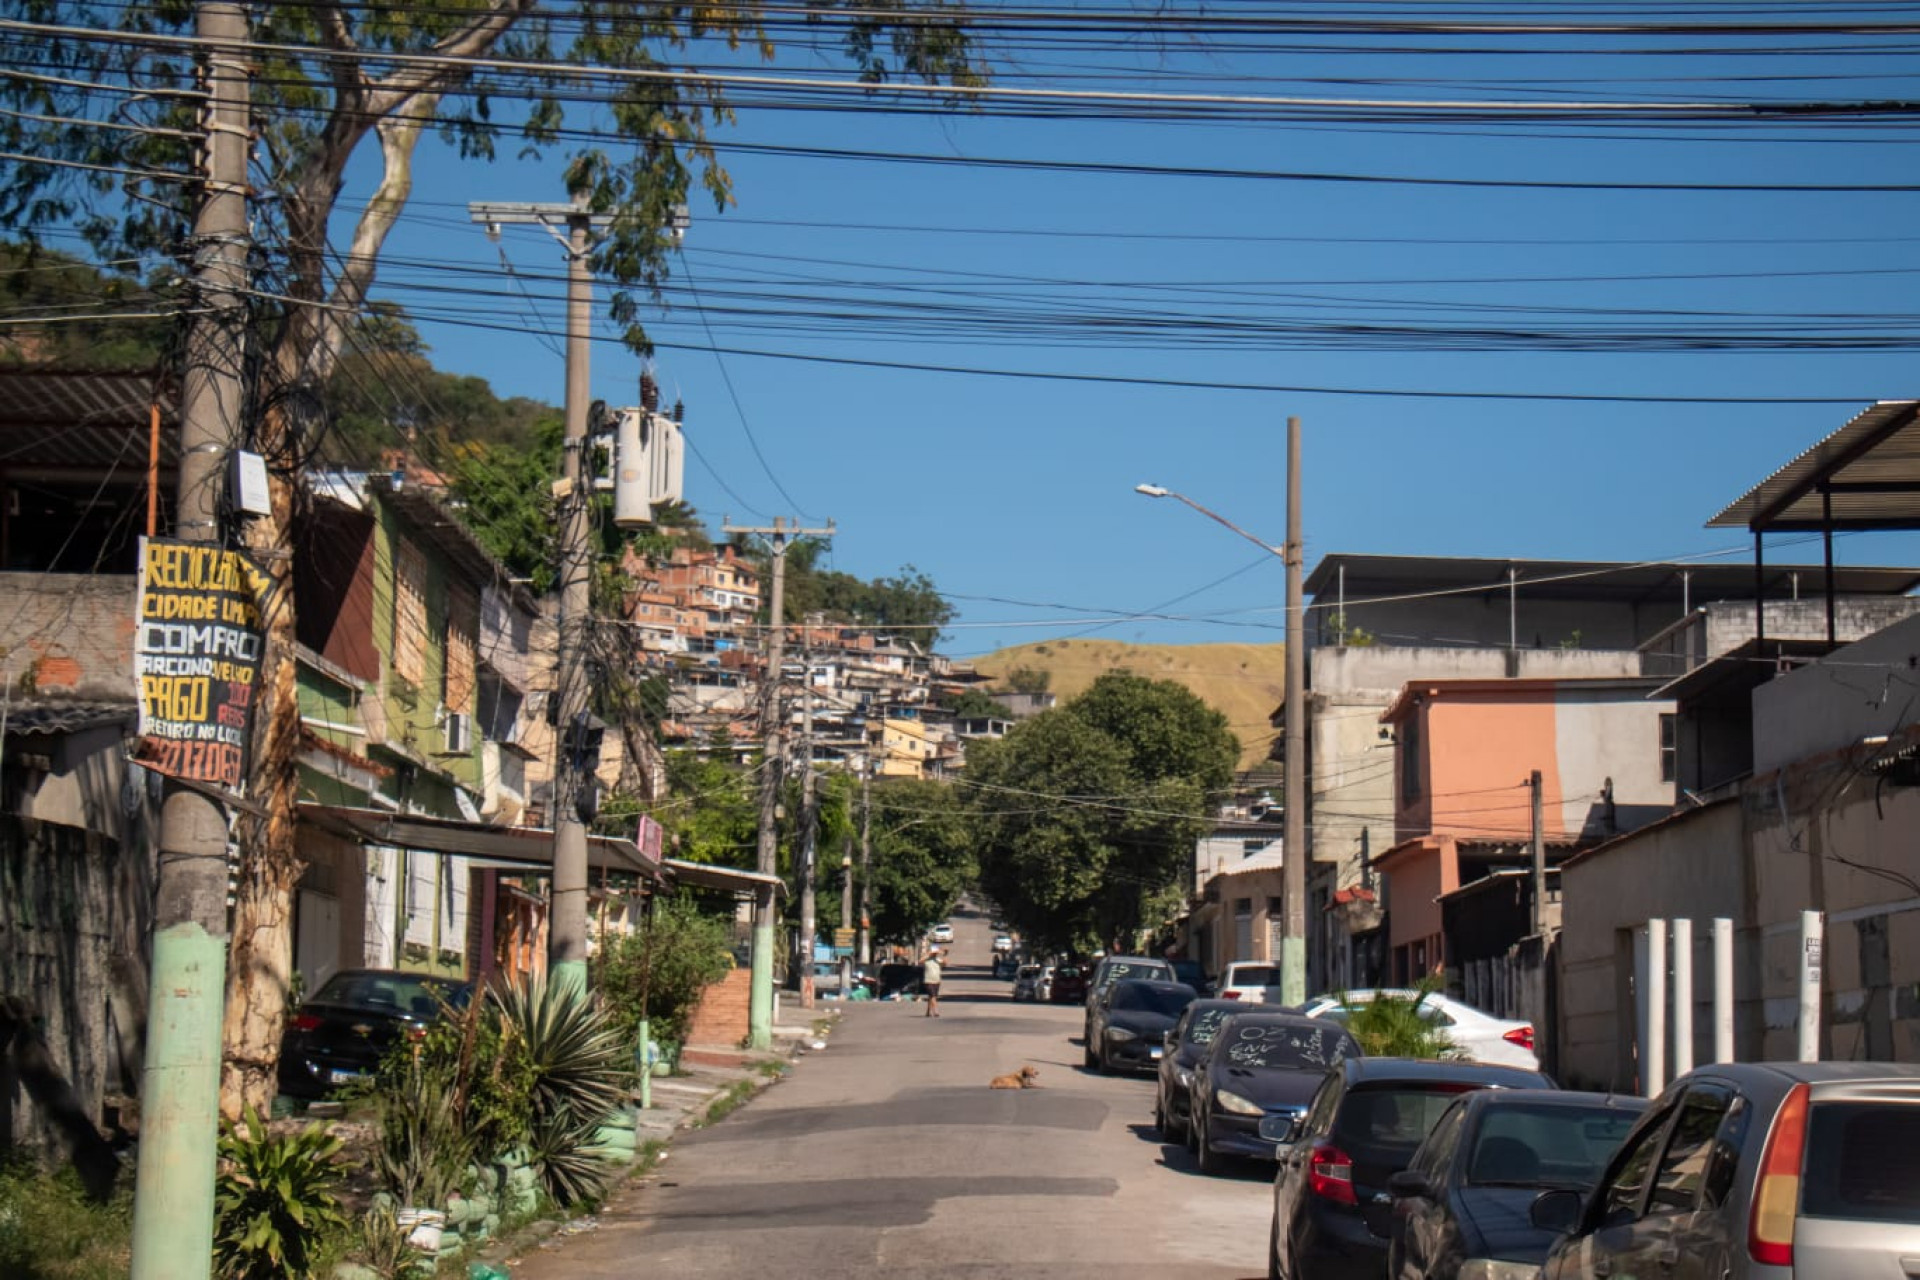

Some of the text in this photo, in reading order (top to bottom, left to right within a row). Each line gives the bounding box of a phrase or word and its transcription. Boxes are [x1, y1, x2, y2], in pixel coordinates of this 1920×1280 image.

[146, 543, 270, 597] RECICLAM
[143, 592, 217, 620] CIDADE
[143, 622, 261, 660] COMPRO
[143, 675, 210, 722] PAGO
[197, 723, 216, 739] NO
